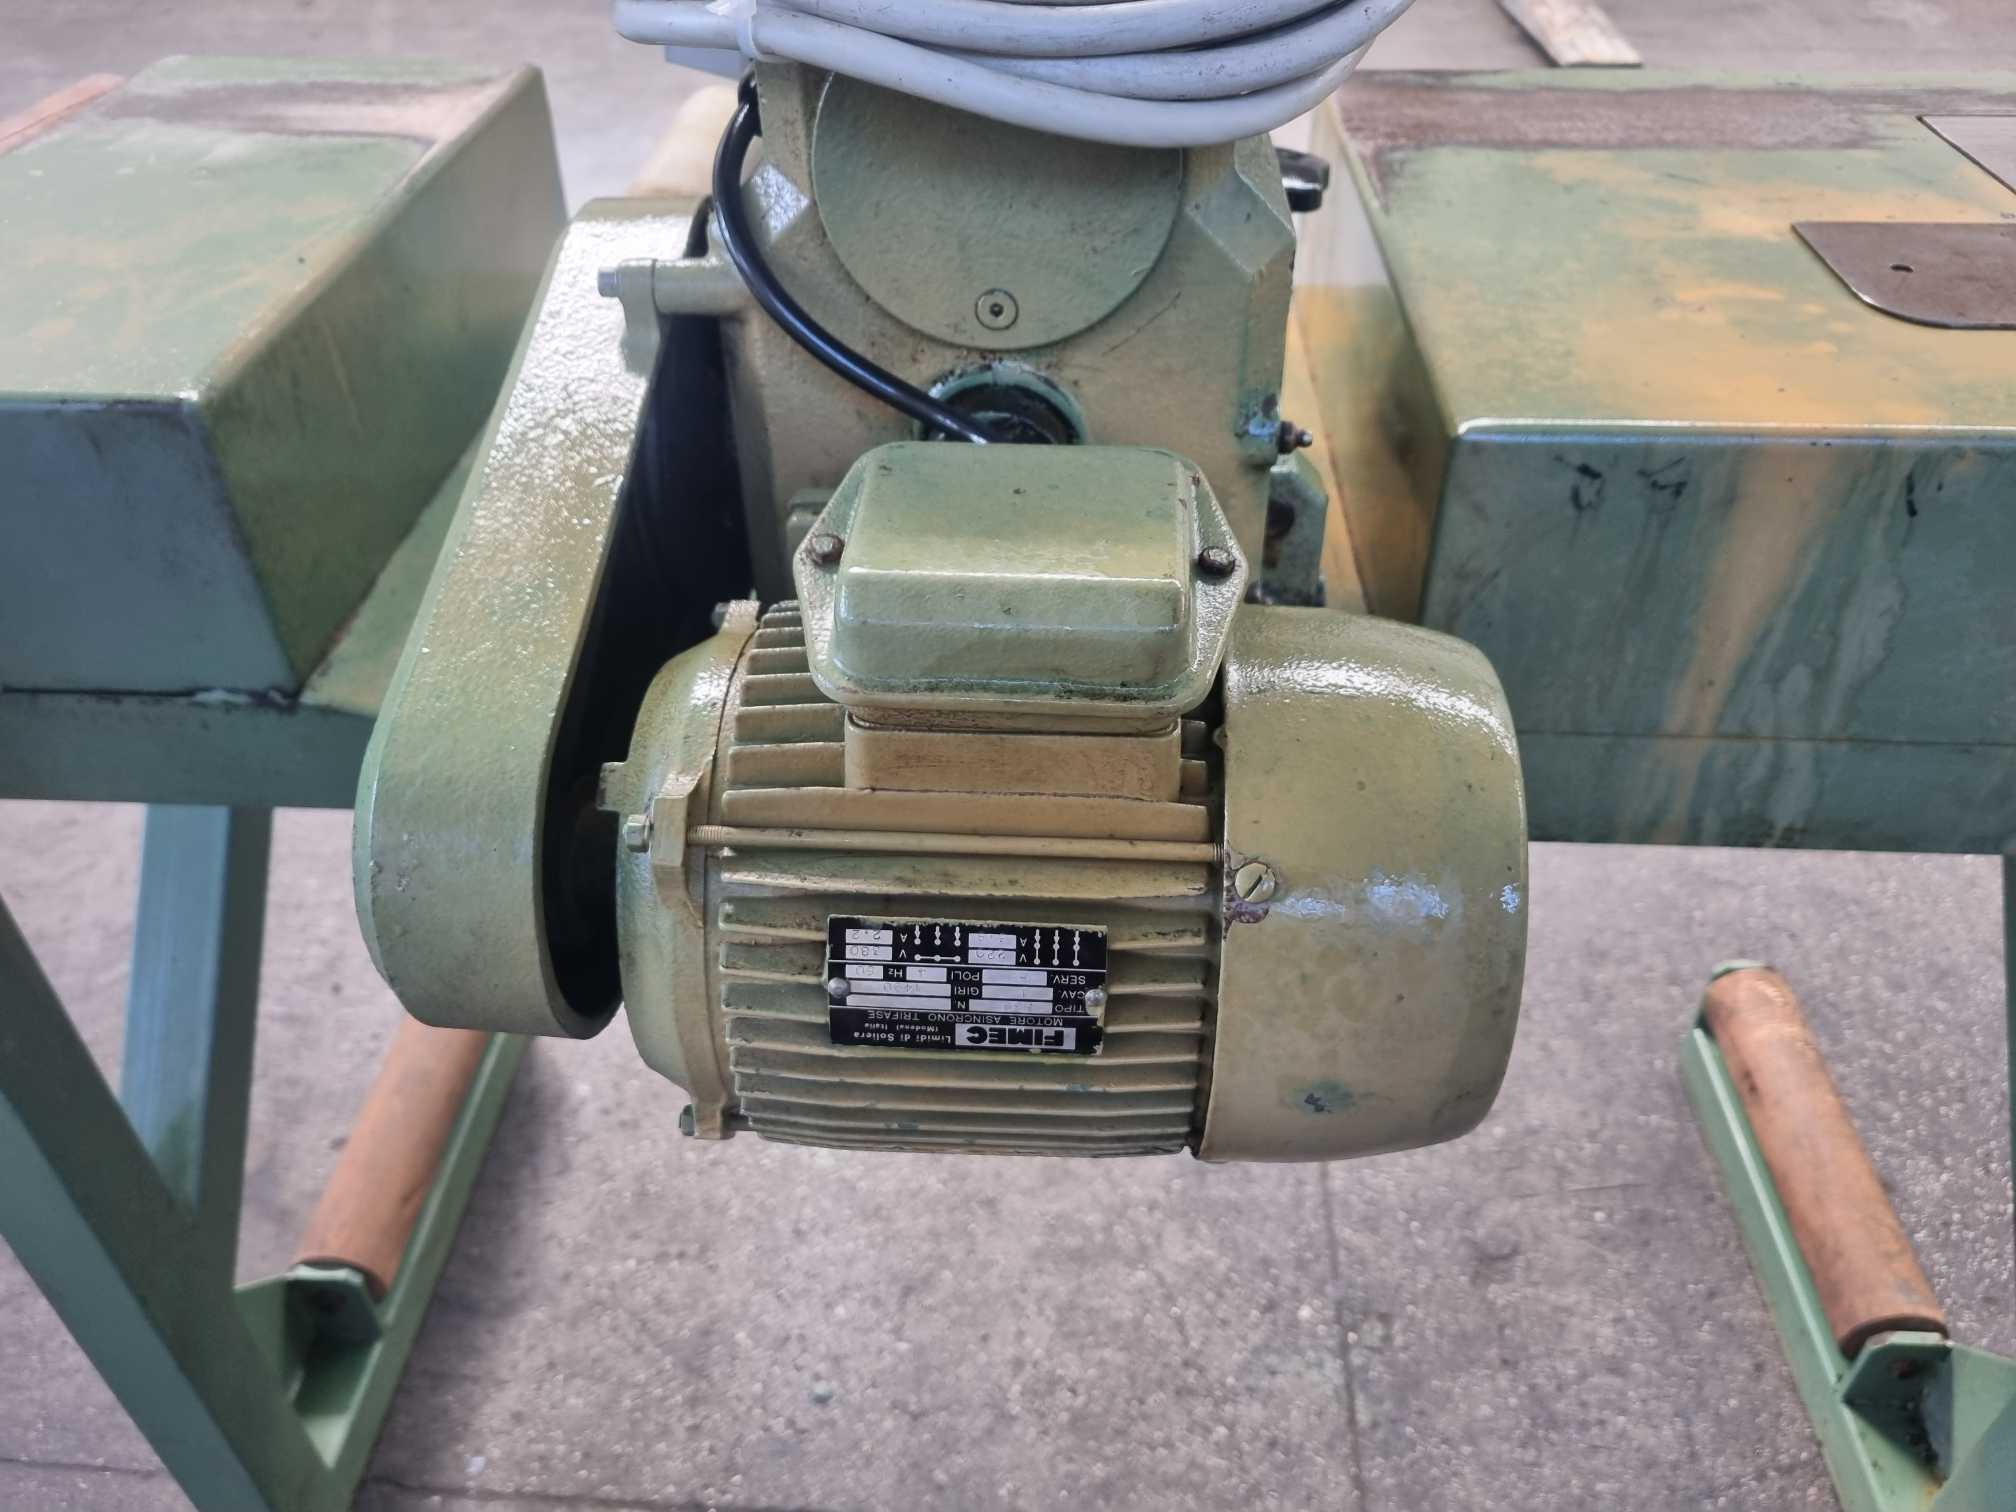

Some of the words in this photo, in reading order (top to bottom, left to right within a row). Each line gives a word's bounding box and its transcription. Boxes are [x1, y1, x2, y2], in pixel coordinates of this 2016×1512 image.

[851, 930, 880, 940] 2.2
[900, 934, 908, 942] A
[1020, 938, 1027, 947] A
[850, 946, 879, 957] 380
[899, 949, 906, 959] V
[1020, 954, 1027, 963] V
[888, 968, 902, 978] Hz
[951, 971, 980, 981] POLI
[1051, 975, 1086, 985] SERV.
[954, 986, 979, 995] GIRI
[1058, 991, 1085, 999] CAV.
[1055, 1004, 1085, 1013] TIPO
[867, 1010, 920, 1021] TRIFASE
[928, 1014, 1001, 1024] ASINCRONO
[1009, 1017, 1063, 1026] MOTORE
[854, 1032, 894, 1041] Soliera
[900, 1034, 910, 1042] di
[916, 1034, 951, 1044] Limidi
[966, 1027, 1064, 1046] FIMEC
